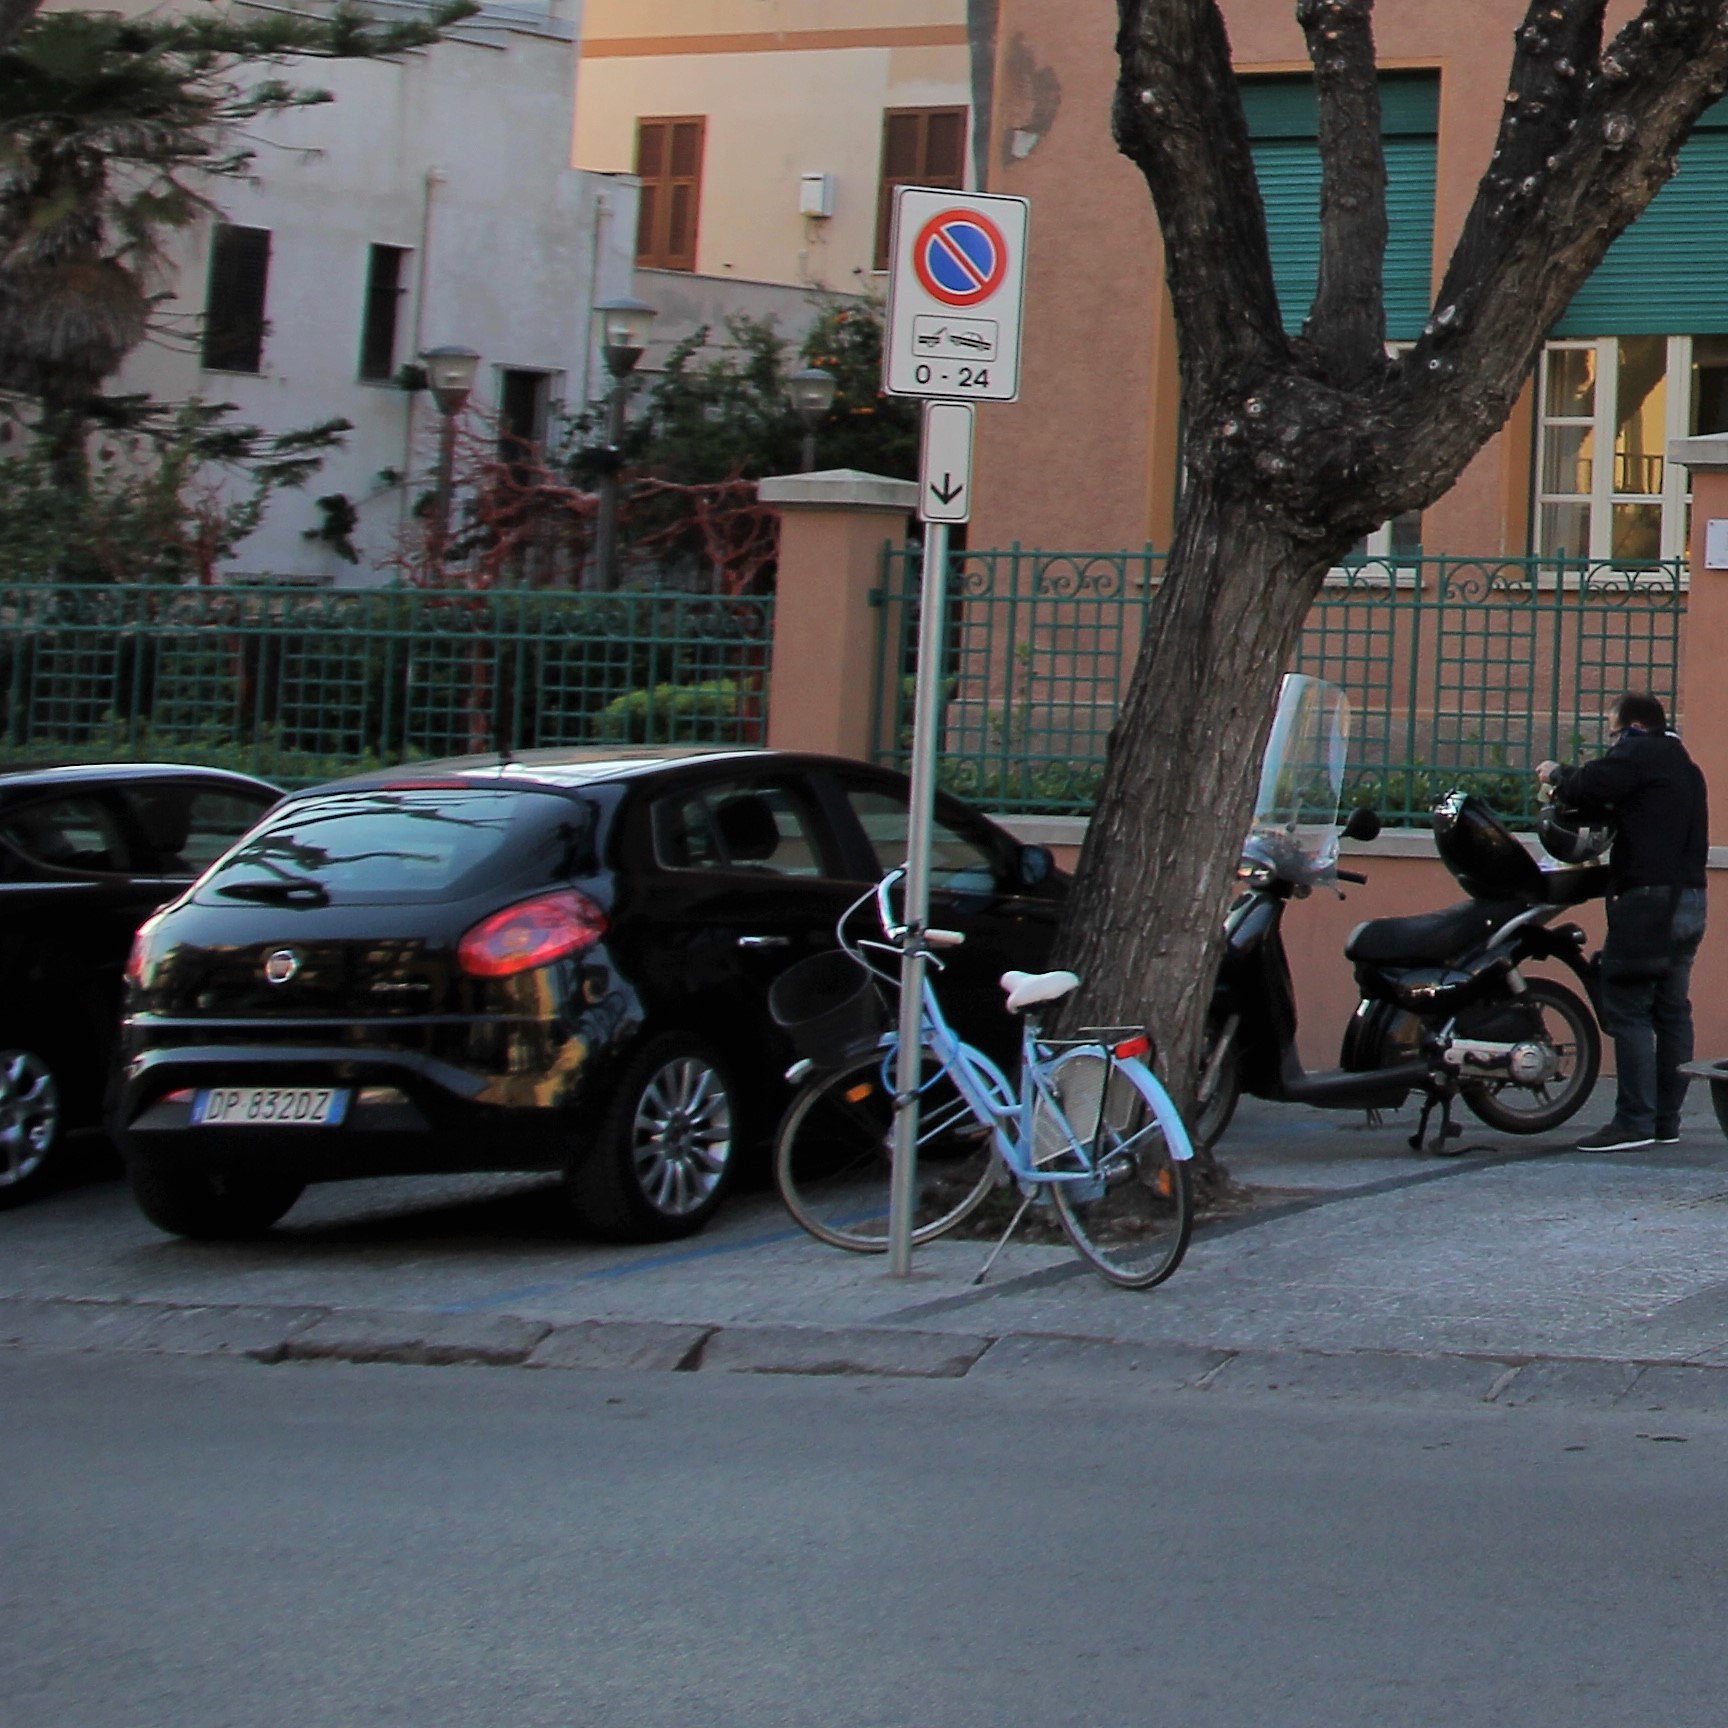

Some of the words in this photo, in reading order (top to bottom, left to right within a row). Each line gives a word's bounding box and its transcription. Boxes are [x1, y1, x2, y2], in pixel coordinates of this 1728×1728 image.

[916, 364, 931, 384] 0
[959, 367, 989, 388] 24
[206, 1092, 239, 1120] DP
[248, 1091, 329, 1120] 832DZ
